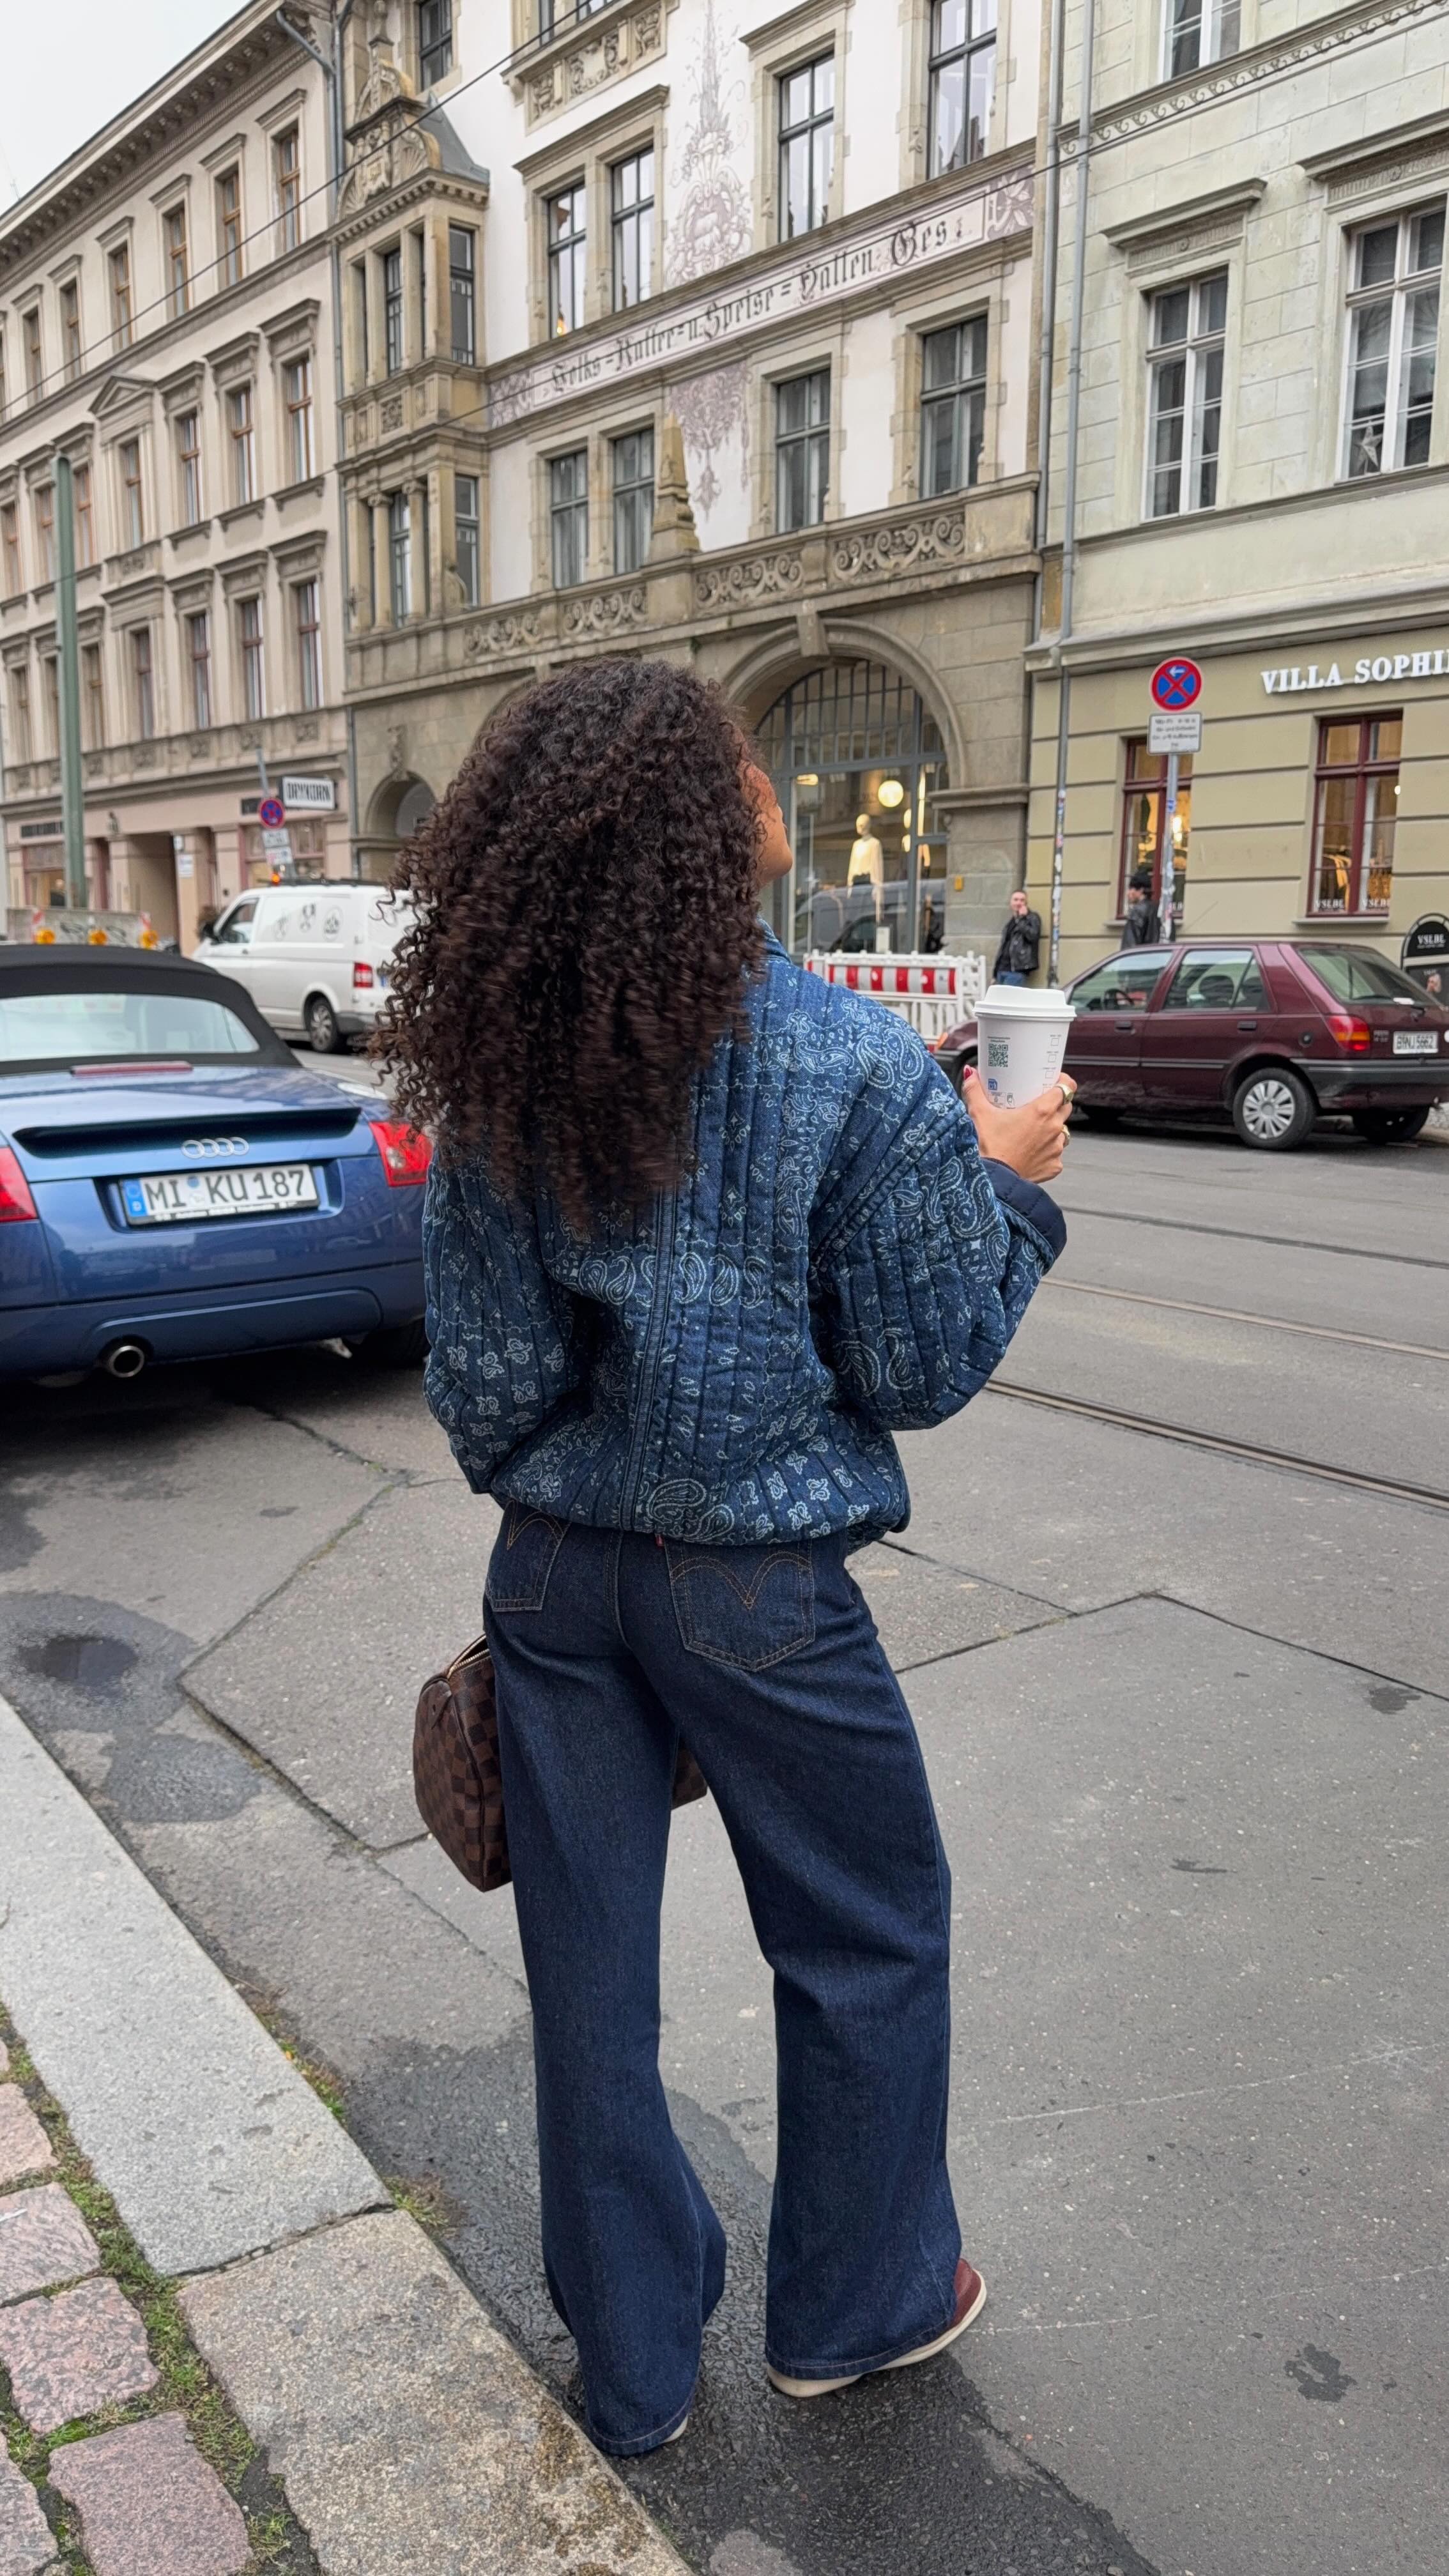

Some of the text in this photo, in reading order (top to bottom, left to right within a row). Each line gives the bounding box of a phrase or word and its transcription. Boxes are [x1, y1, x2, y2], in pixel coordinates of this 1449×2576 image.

[1261, 648, 1449, 694] VILLA SOPHI
[144, 1170, 305, 1210] MI KU 187
